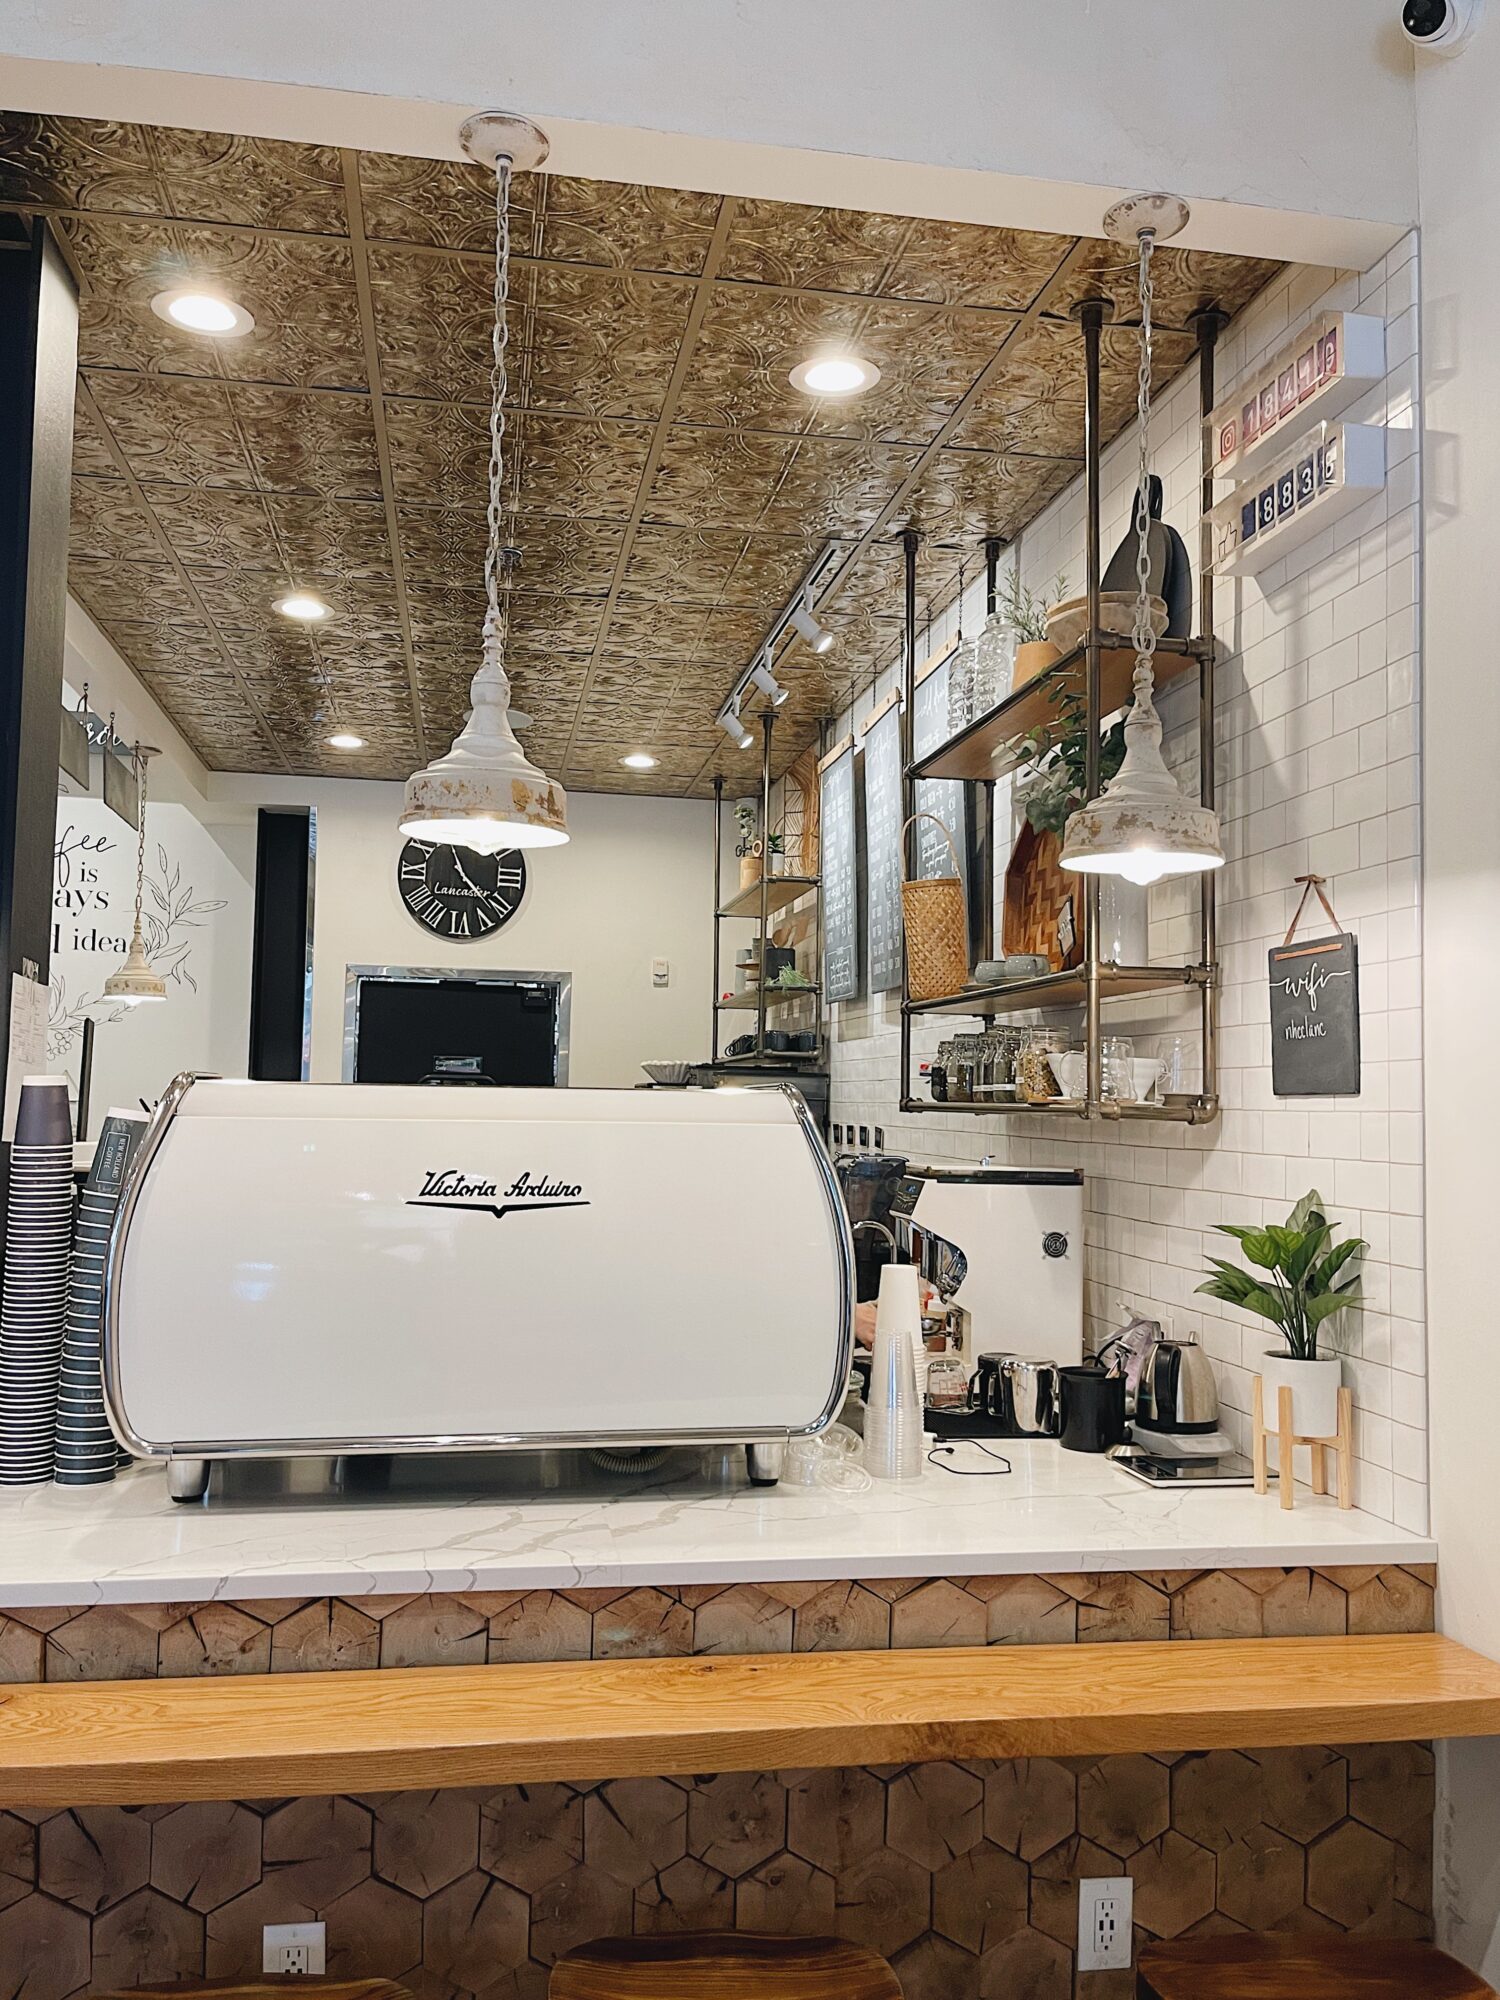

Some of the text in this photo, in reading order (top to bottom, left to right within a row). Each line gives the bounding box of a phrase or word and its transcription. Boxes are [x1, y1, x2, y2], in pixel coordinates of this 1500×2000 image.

[54, 825, 117, 888] fee
[80, 861, 98, 882] is
[497, 866, 522, 890] III
[54, 888, 109, 917] ays
[434, 881, 491, 898] Lancaster
[72, 928, 127, 953] idea
[1276, 962, 1340, 1011] wifi
[103, 1146, 114, 1169] COFFEE
[112, 1138, 126, 1179] NEW HOLLAND
[418, 1169, 582, 1197] Victoria Arduino
